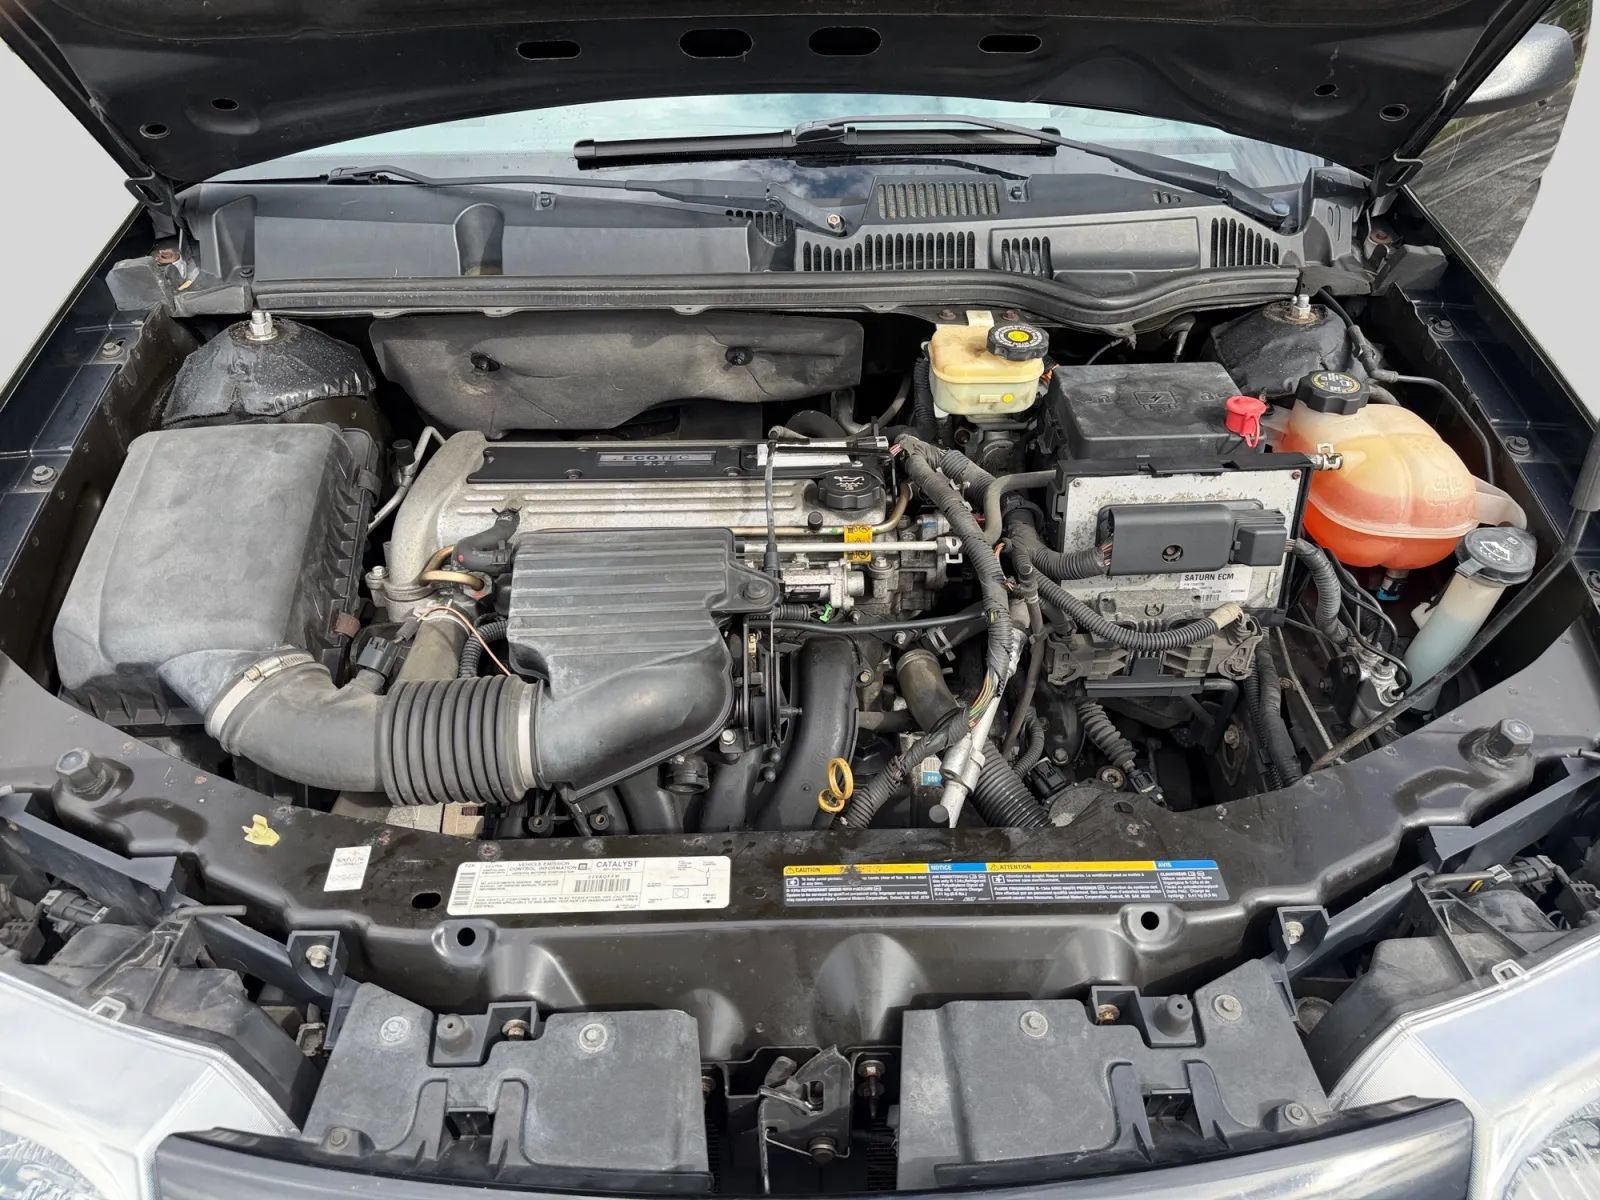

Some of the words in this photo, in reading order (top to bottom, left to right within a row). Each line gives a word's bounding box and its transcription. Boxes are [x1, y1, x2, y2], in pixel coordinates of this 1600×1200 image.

[1184, 573, 1215, 581] SATURN
[1217, 573, 1235, 581] ECM
[596, 860, 639, 868] CATALYST
